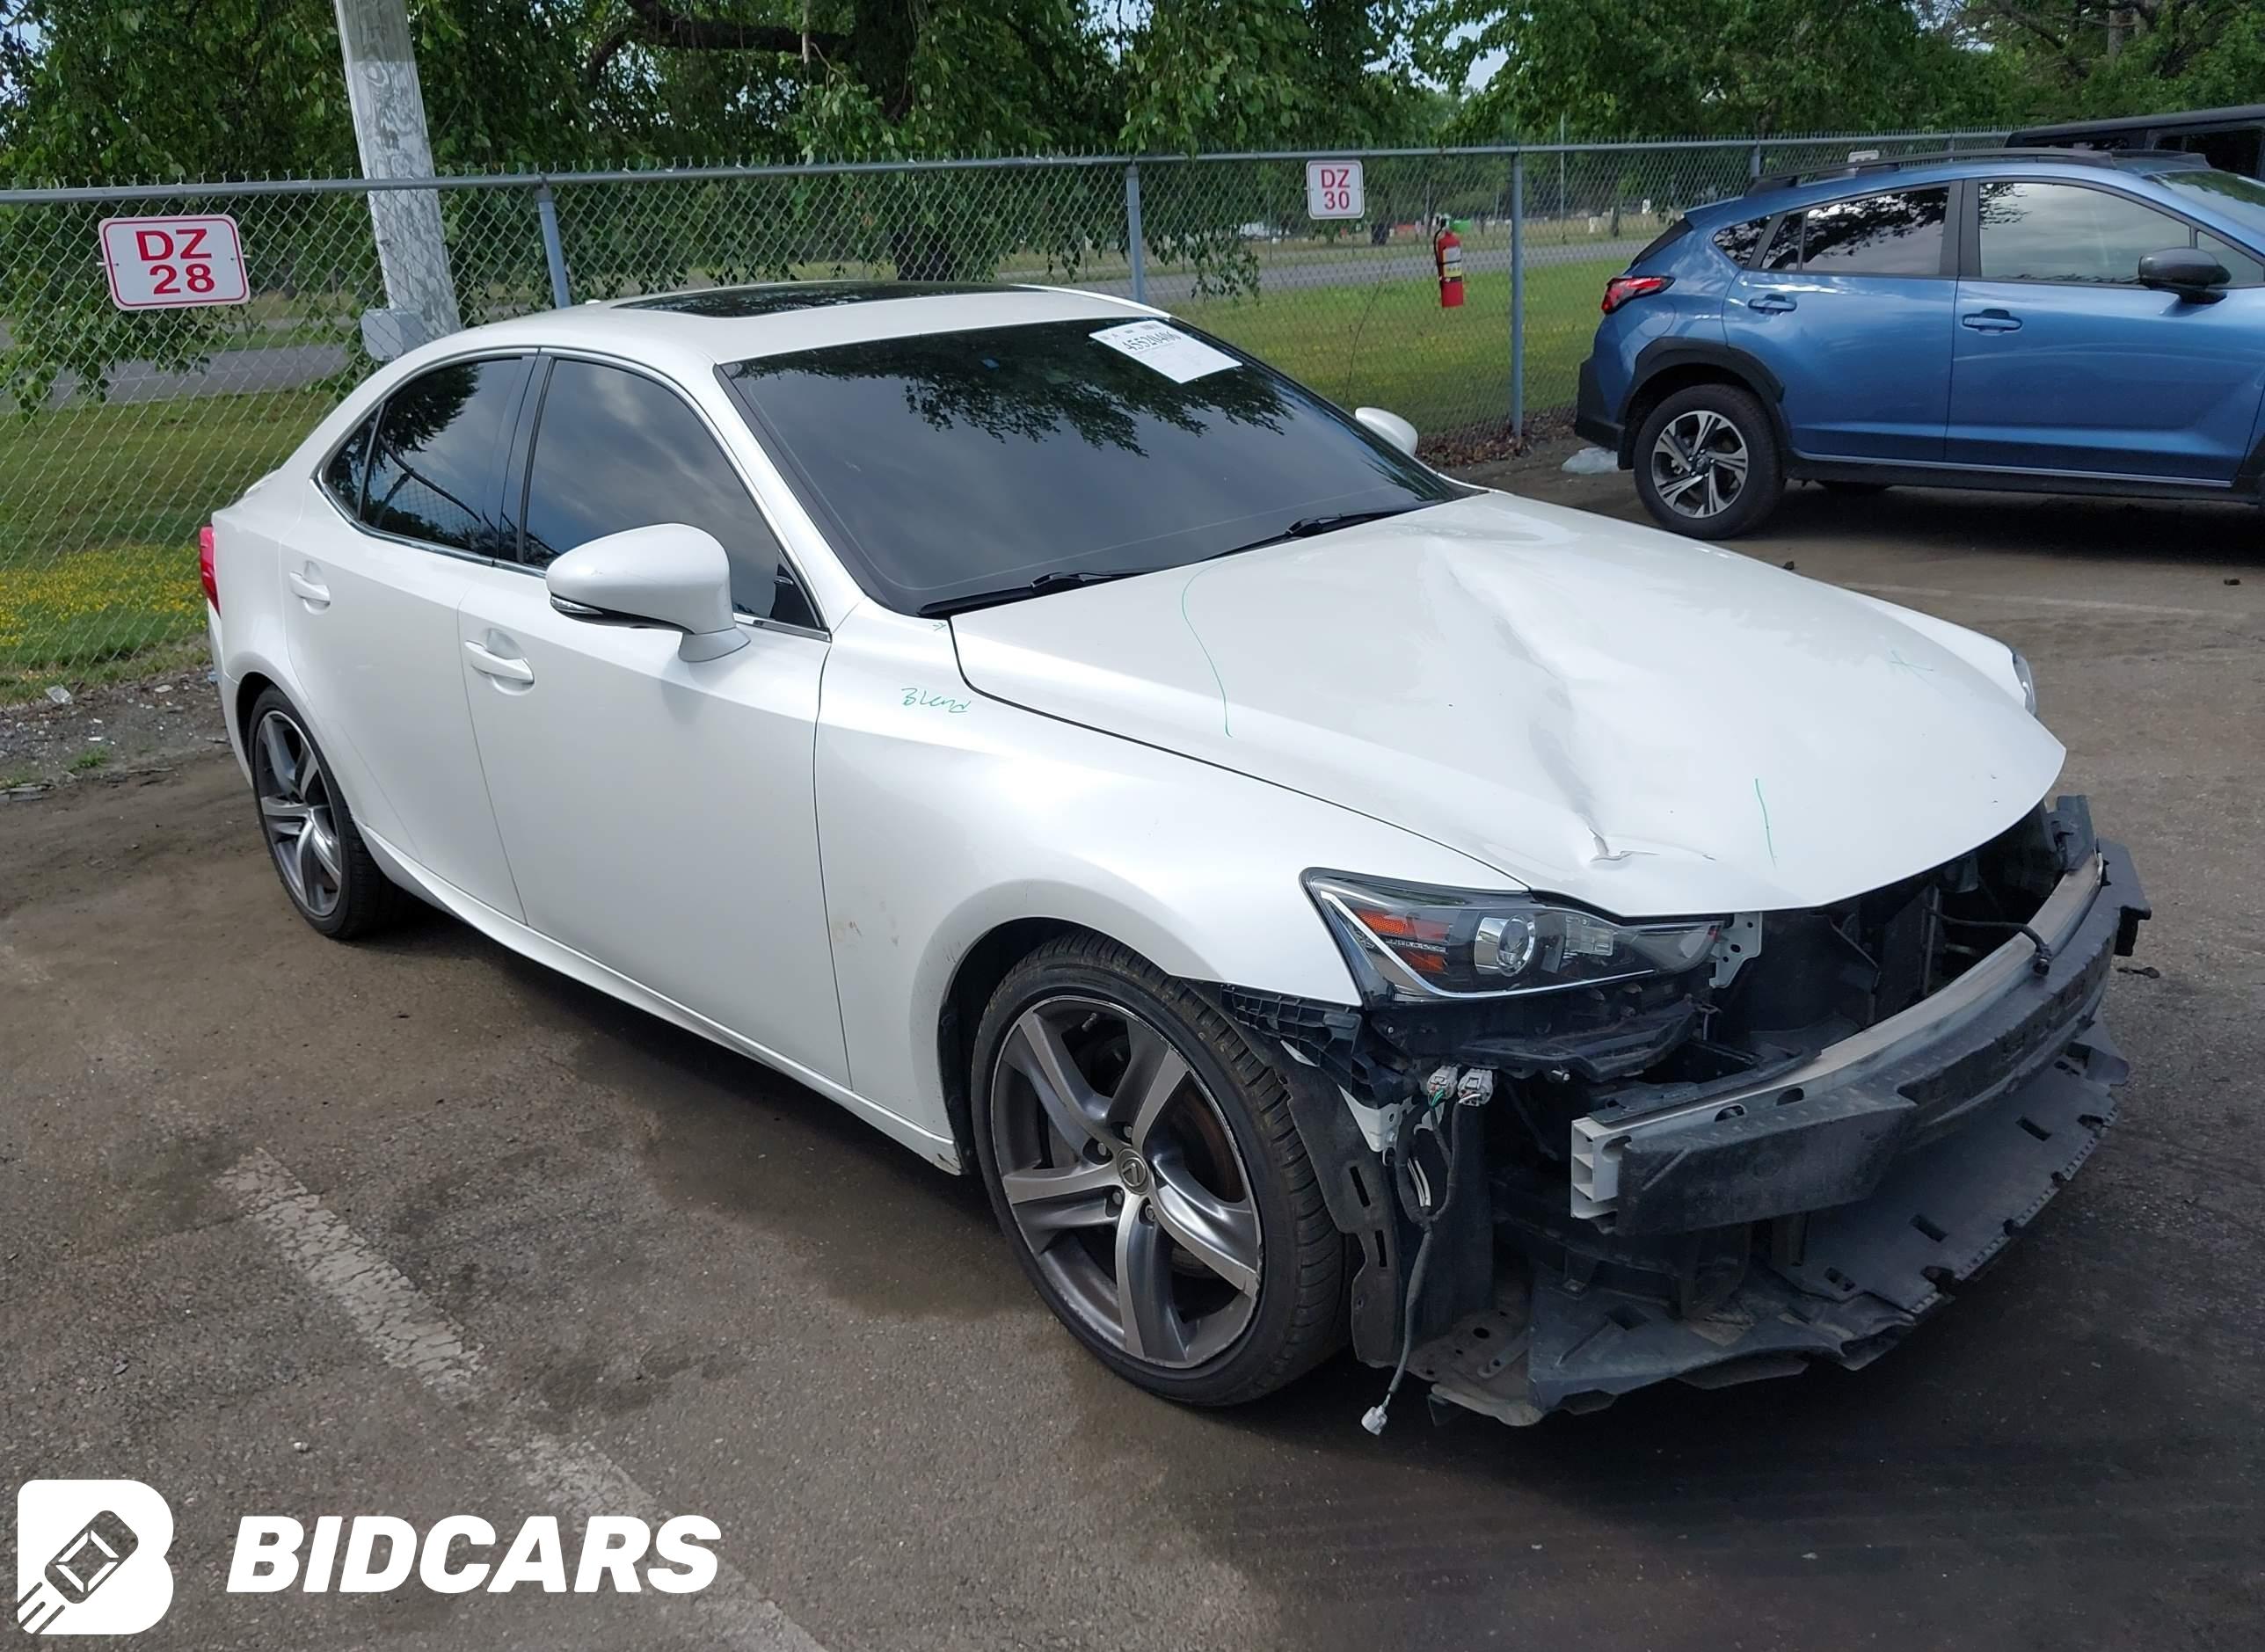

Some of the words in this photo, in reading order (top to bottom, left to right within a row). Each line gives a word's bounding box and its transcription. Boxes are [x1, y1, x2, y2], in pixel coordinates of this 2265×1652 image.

[1321, 168, 1351, 189] DZ
[1323, 190, 1350, 211] 30
[135, 228, 212, 262] DZ
[149, 263, 215, 295] 28
